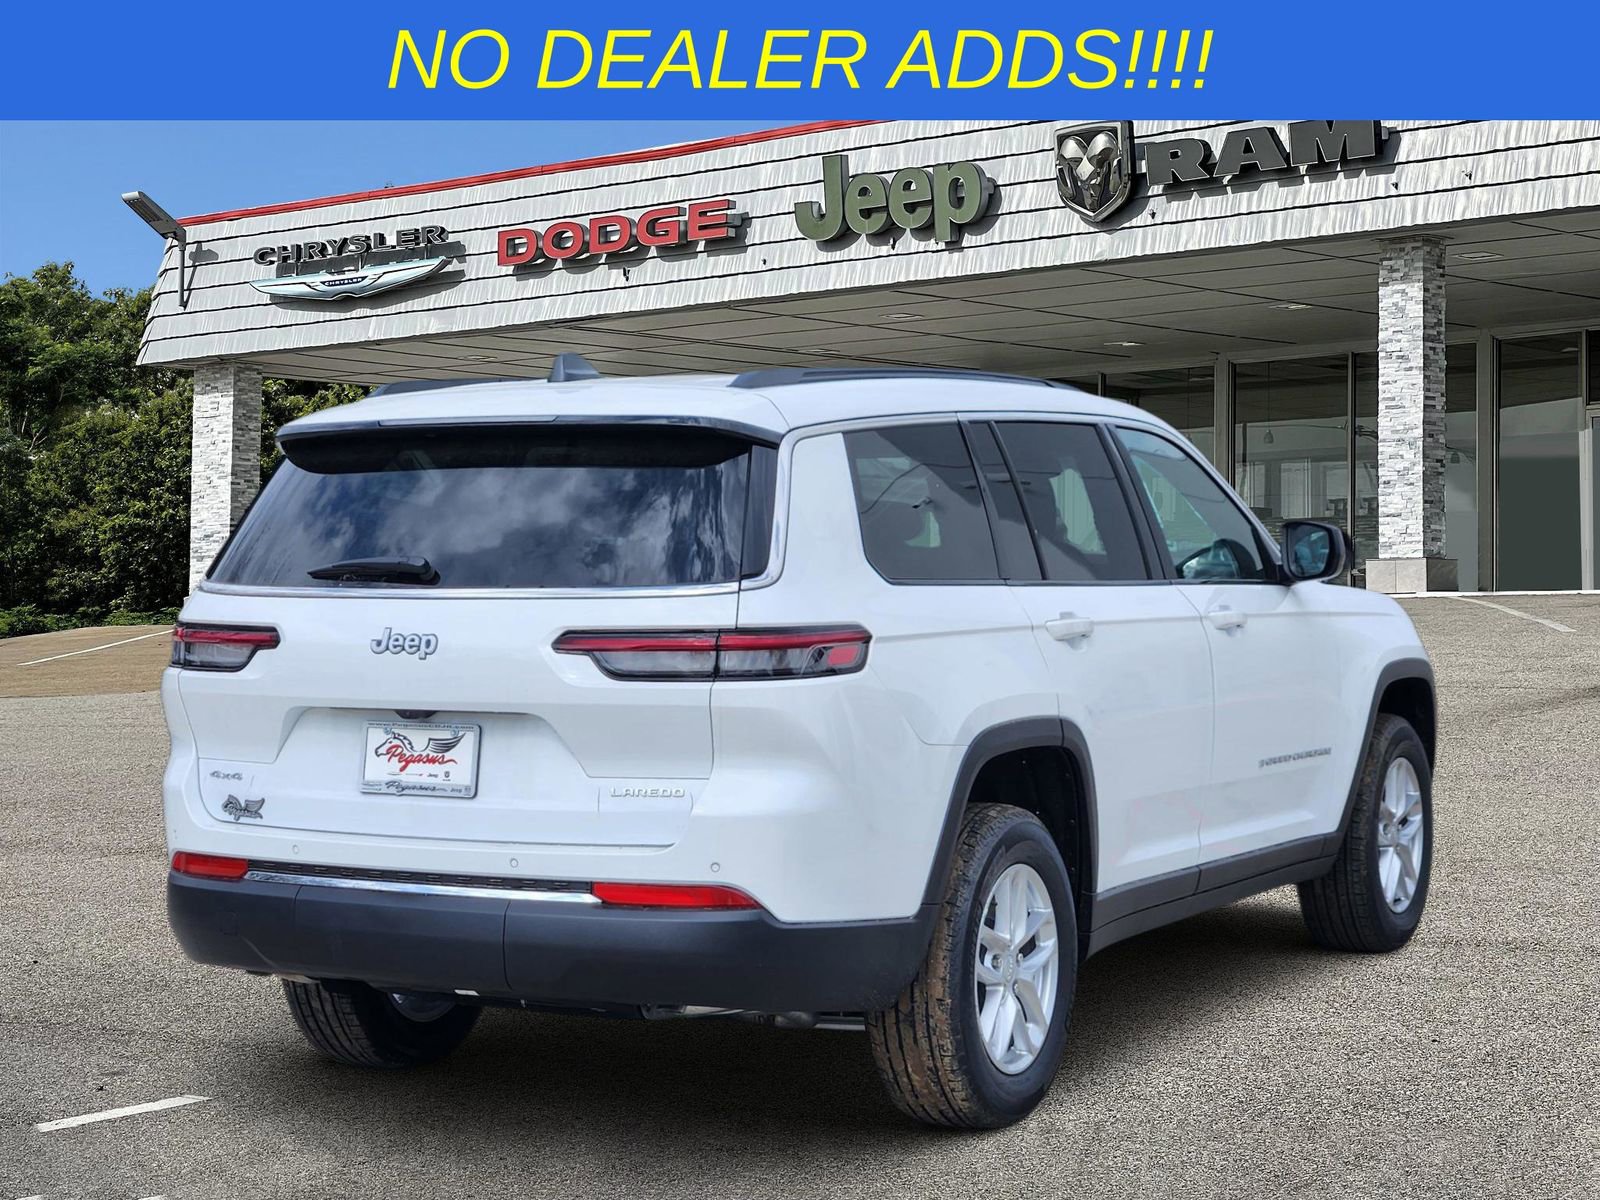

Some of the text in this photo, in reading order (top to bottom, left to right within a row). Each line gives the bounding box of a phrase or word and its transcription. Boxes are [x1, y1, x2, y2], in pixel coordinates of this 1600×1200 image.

[1144, 119, 1378, 186] RAM
[794, 154, 990, 243] Jeep
[253, 225, 449, 267] CHRYSLER
[498, 199, 737, 267] DODGE
[370, 627, 438, 660] Jeep
[385, 743, 458, 772] Pegasus
[610, 786, 685, 798] LAREDO
